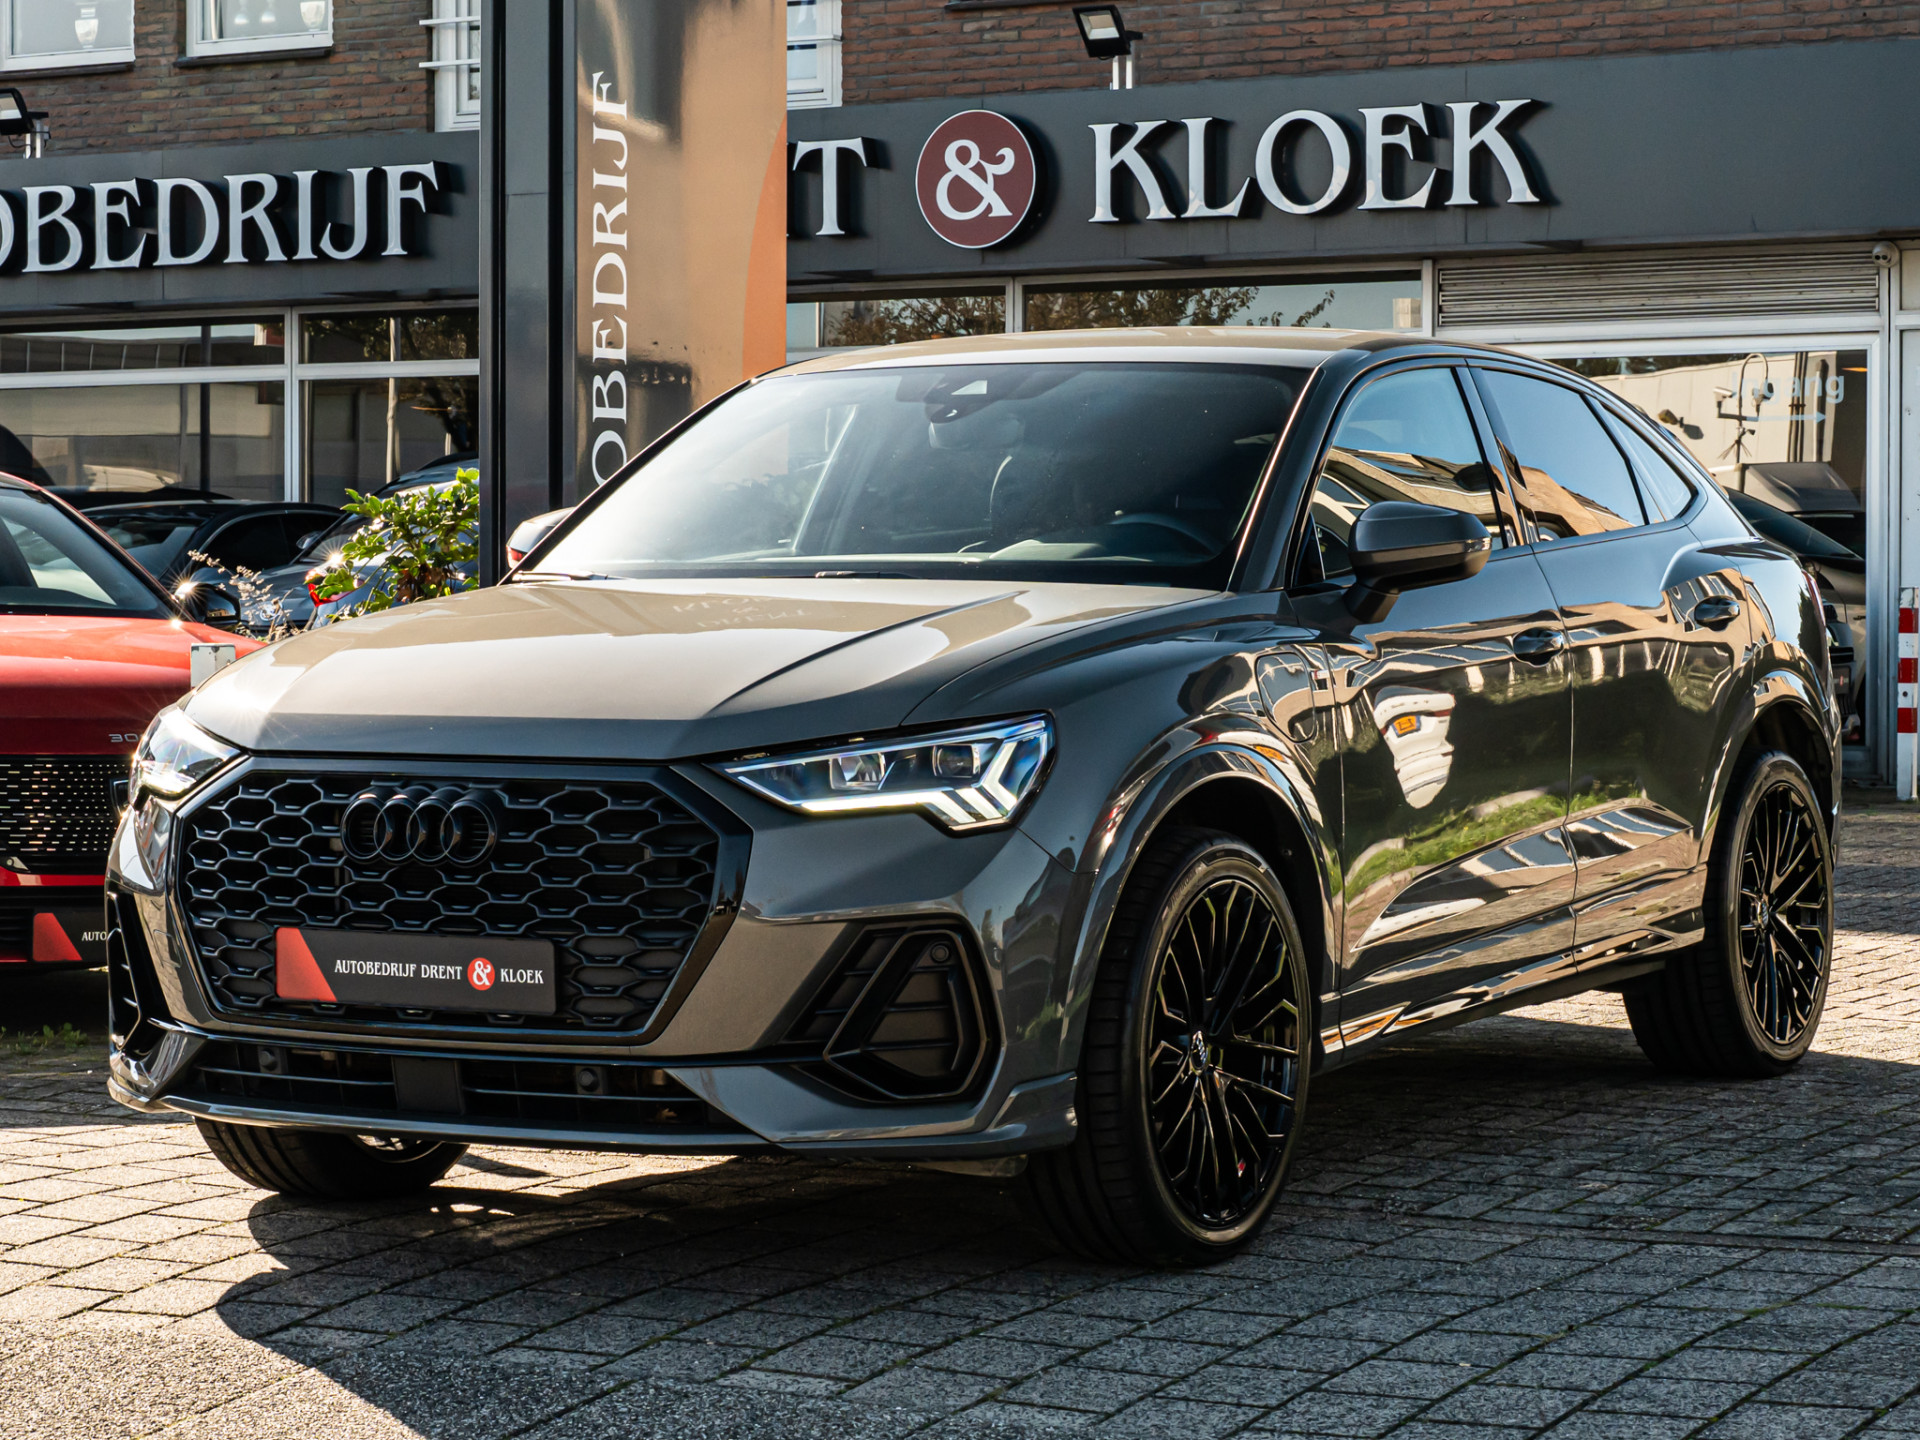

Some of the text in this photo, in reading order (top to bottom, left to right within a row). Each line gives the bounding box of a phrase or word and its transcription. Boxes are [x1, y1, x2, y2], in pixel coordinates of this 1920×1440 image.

[0, 98, 1541, 273] BEDRIJF T & KLOEK
[592, 71, 628, 487] OBEDRIJF
[1731, 371, 1845, 405] Ingang
[108, 733, 142, 743] 30
[81, 931, 107, 942] AUTO
[334, 959, 544, 986] AUTOBEDRIJF DRENT & KLOEK
